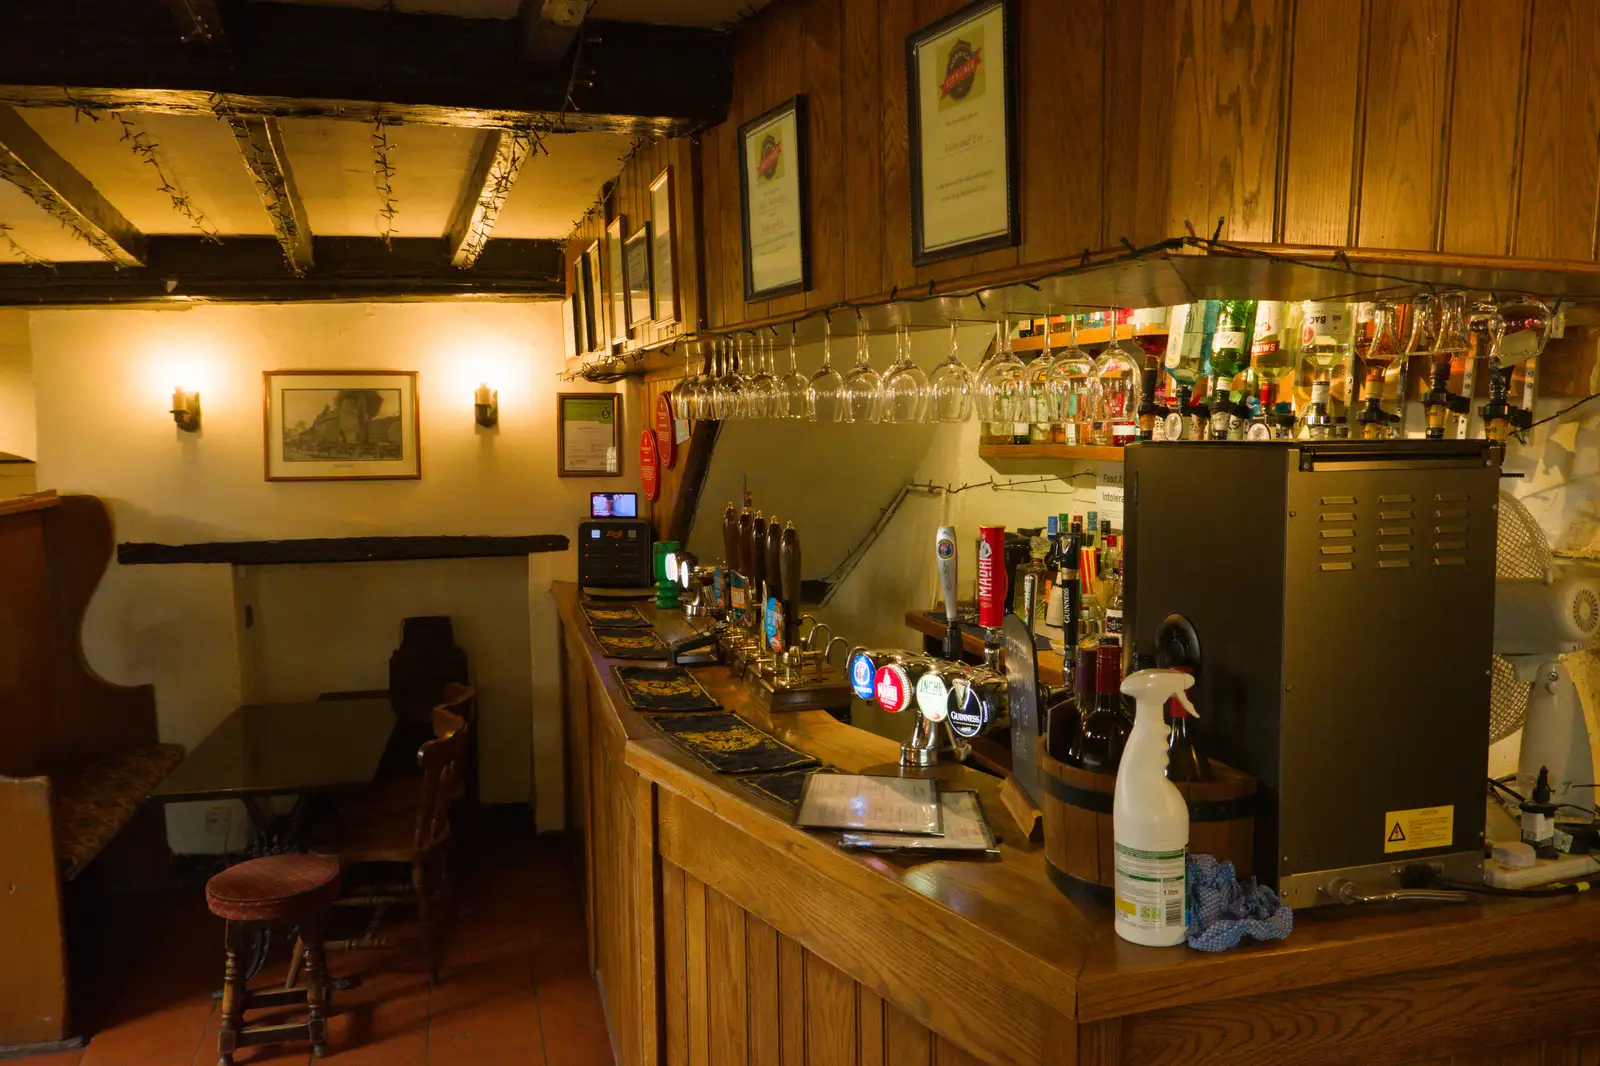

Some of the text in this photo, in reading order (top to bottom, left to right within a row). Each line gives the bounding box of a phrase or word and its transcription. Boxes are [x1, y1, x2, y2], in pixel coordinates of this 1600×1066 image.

[963, 60, 977, 73] ALE
[1103, 473, 1117, 485] Food
[950, 711, 981, 724] GUINNESS
